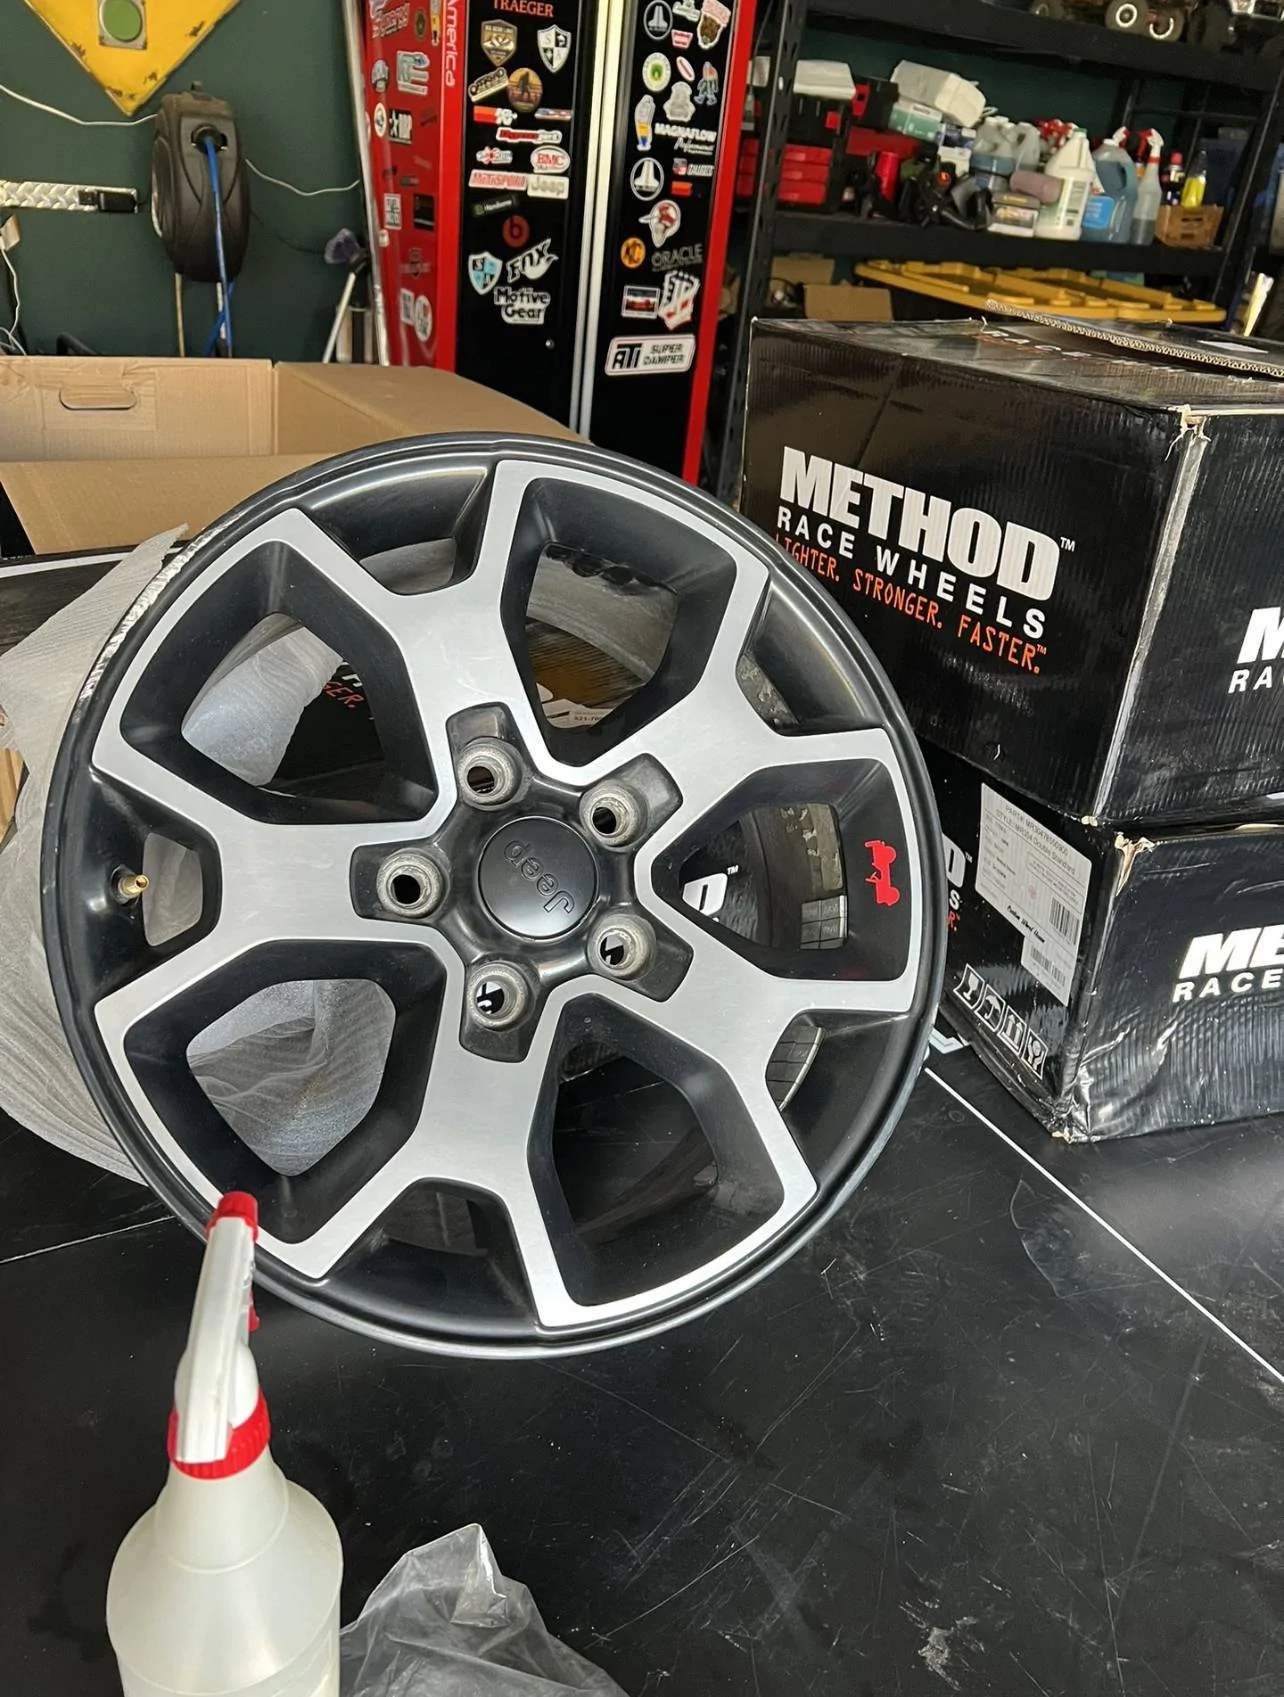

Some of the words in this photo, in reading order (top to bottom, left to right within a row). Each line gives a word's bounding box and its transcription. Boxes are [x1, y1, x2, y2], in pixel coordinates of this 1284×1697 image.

[446, 0, 458, 86] merica
[531, 176, 566, 196] Jeep
[651, 244, 704, 268] ORACLE
[497, 287, 549, 304] Motive
[505, 304, 542, 319] Gear
[643, 354, 685, 366] DAMPER
[651, 344, 684, 354] SUPER
[780, 446, 1060, 601] METHOD
[777, 505, 855, 559] RACE
[876, 545, 1046, 639] WHEELS
[853, 568, 943, 630] STRONGER.
[957, 614, 1041, 674] FASTER.
[1228, 665, 1284, 694] RA
[504, 841, 575, 914] Jeep
[1173, 968, 1284, 1003] RACE
